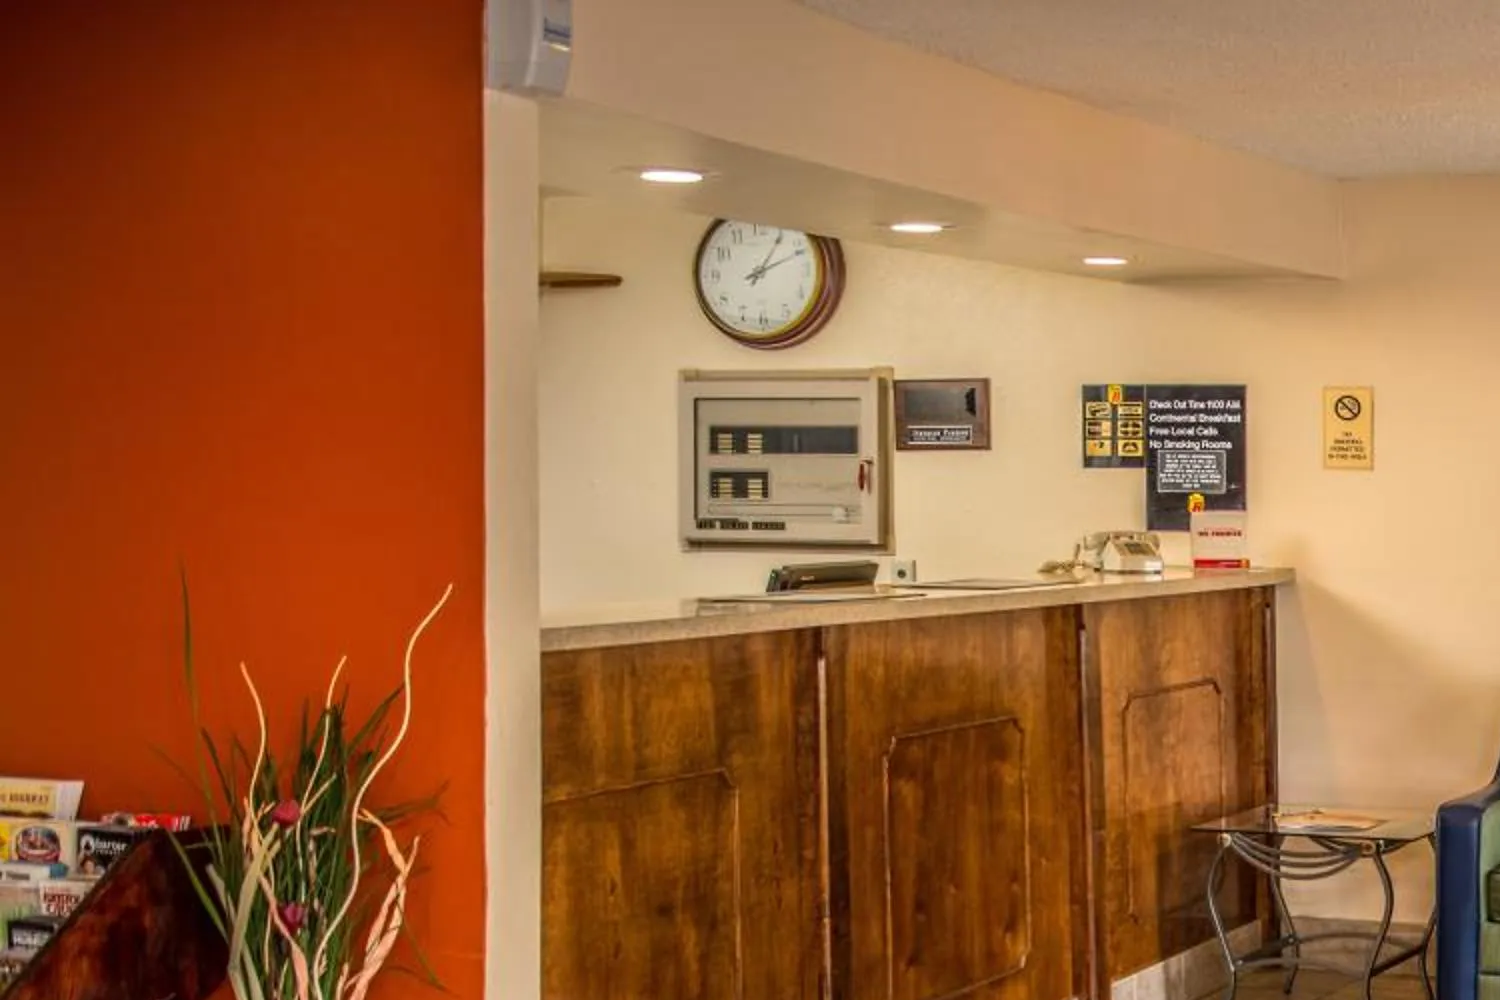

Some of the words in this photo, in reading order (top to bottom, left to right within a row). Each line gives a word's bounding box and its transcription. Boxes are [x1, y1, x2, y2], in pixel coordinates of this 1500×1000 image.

[731, 228, 743, 244] 11
[1149, 400, 1172, 409] Check
[1174, 400, 1187, 409] Out
[1188, 400, 1205, 409] Time
[1149, 413, 1197, 423] Continental
[1199, 413, 1241, 423] Breakfast
[1149, 427, 1170, 436] Free
[1171, 427, 1195, 436] Local
[1196, 427, 1219, 436] Calls
[1149, 440, 1162, 449] No
[1164, 440, 1200, 451] Smoking
[1202, 440, 1233, 449] Rooms
